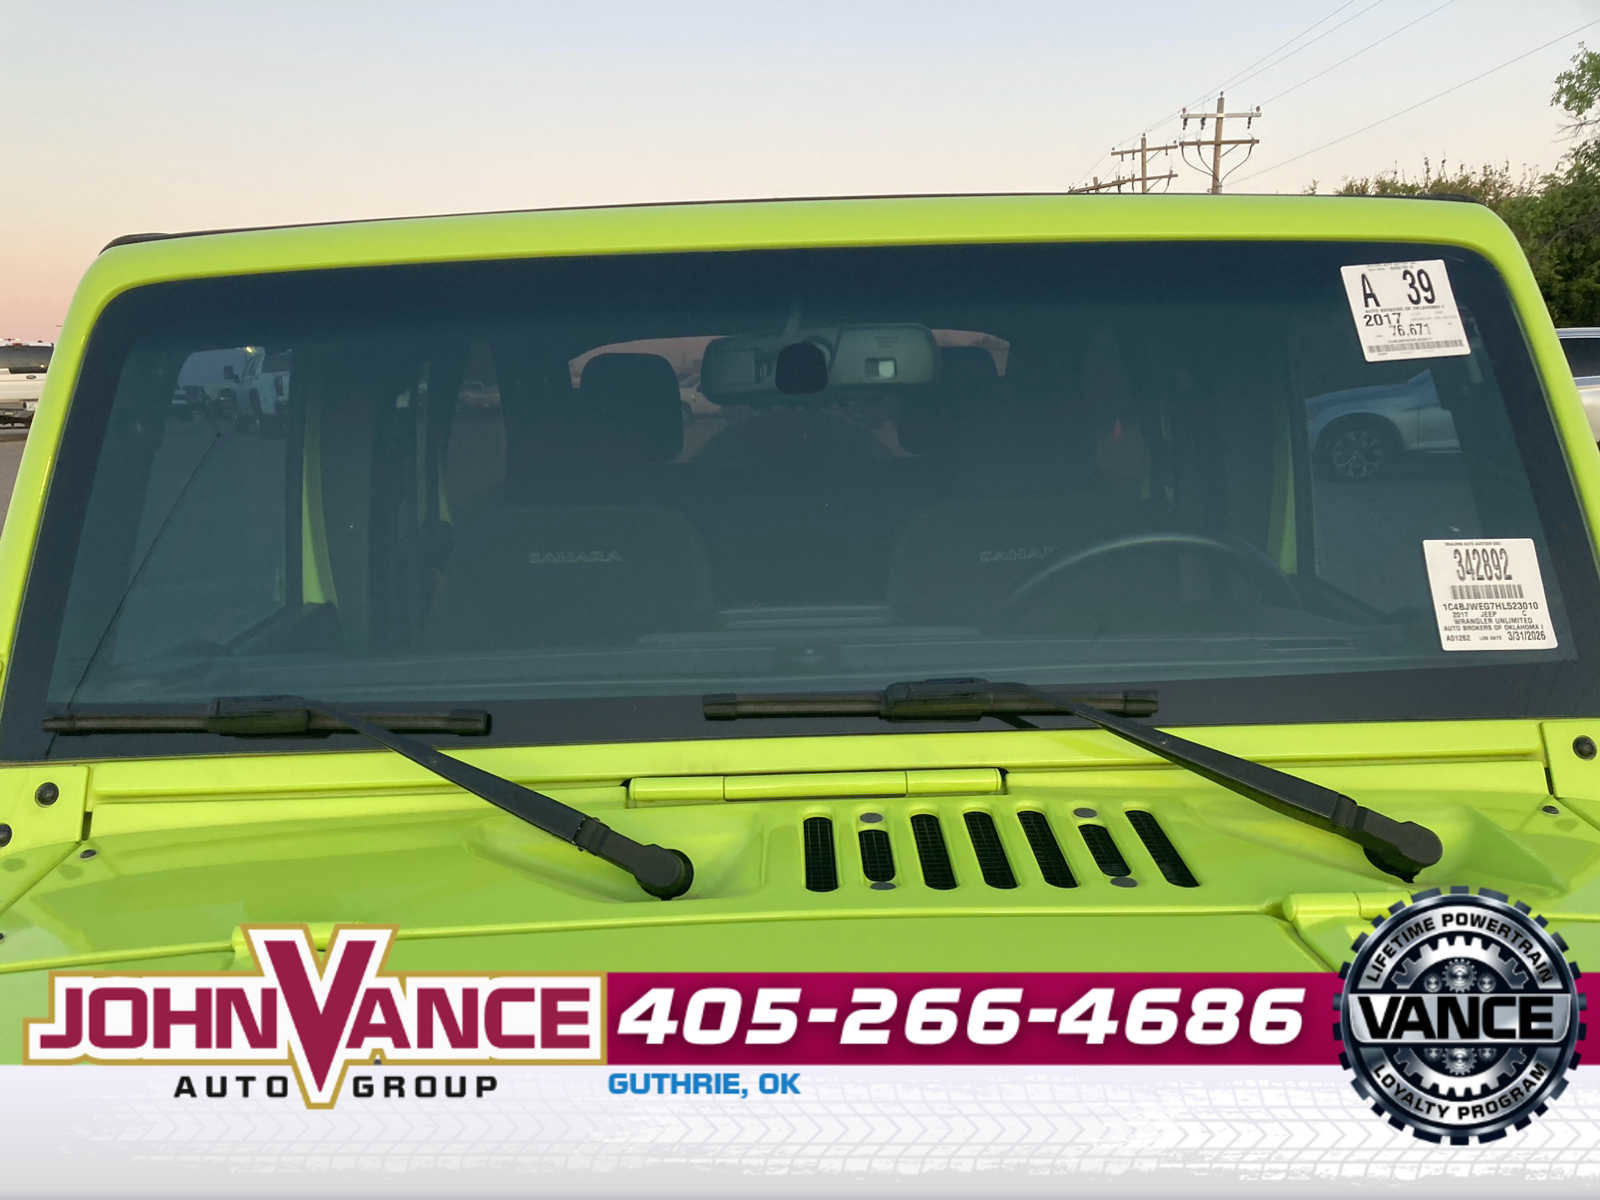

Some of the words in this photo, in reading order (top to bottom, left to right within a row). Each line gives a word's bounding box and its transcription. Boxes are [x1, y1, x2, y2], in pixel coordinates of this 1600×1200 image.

[1361, 273, 1380, 308] A
[1402, 268, 1435, 305] 39
[1363, 312, 1401, 327] 2017
[1453, 548, 1512, 581] 342892
[1507, 631, 1546, 641] 3/31/2026
